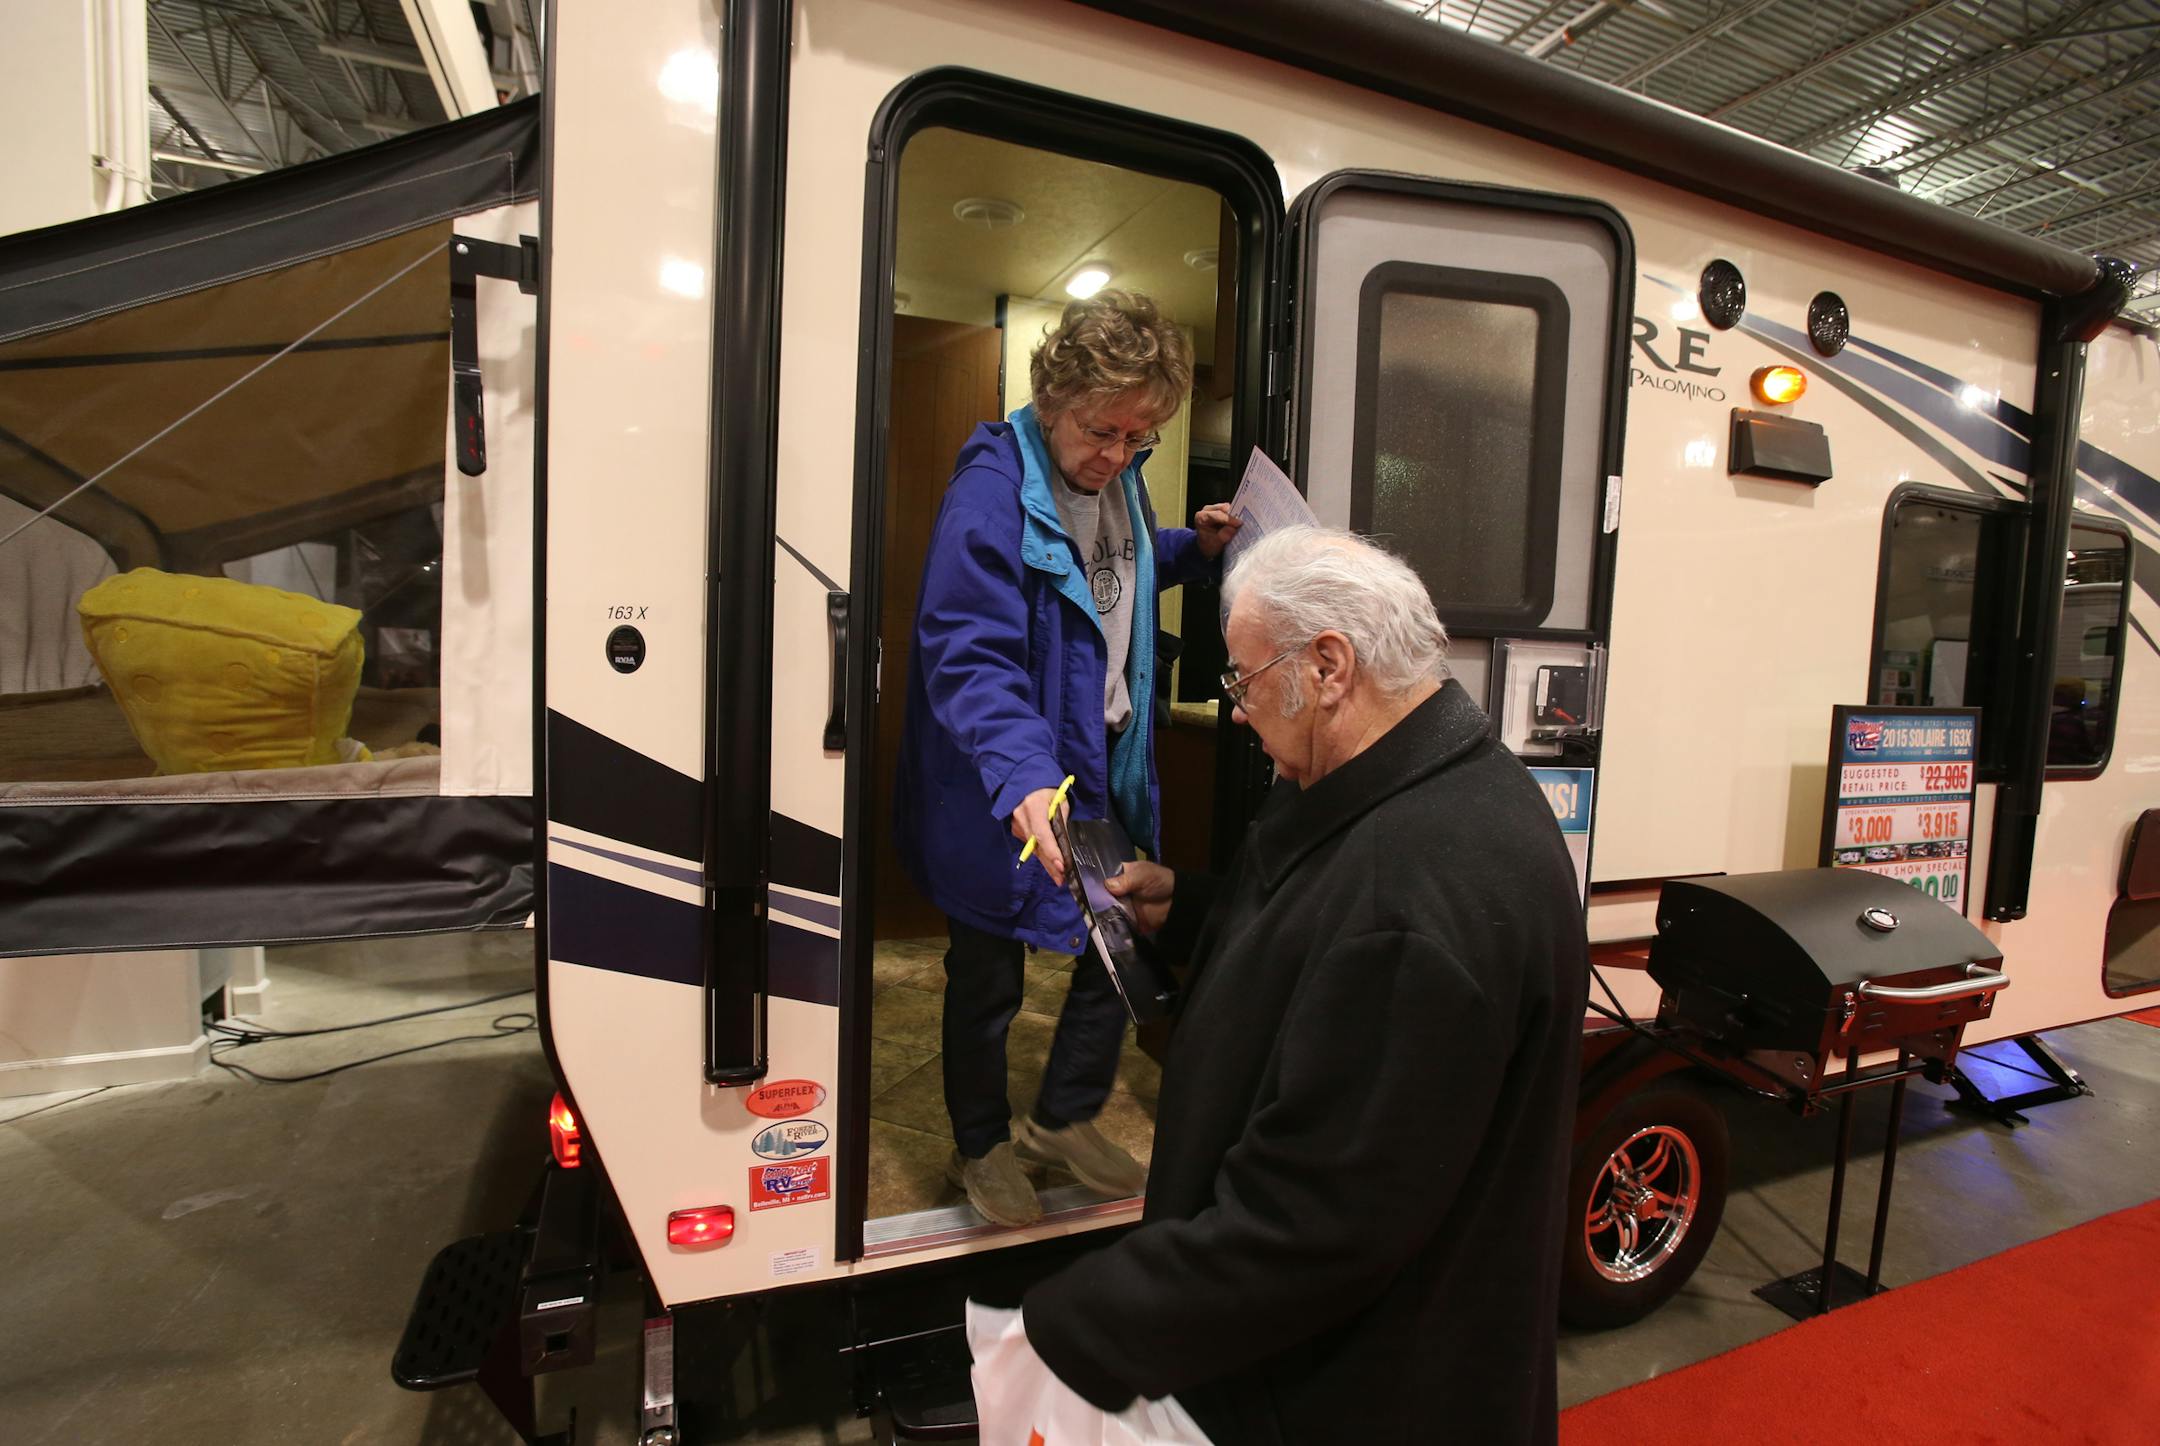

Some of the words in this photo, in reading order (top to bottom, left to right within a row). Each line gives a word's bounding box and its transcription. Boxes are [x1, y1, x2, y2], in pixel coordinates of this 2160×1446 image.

[1630, 368, 1726, 401] PALOMINO
[608, 606, 634, 619] 163
[636, 606, 649, 619] X
[1882, 728, 1908, 748] 2015
[1909, 728, 1947, 748] SOLAIRE
[1949, 728, 1972, 748] 163X
[1843, 768, 1900, 779] SUGGESTED
[1842, 782, 1874, 793] RETAIL
[1849, 815, 1893, 844] $3,000
[1918, 811, 1958, 839] $3,915
[1895, 865, 1922, 875] SHOW
[759, 1086, 814, 1100] SUPERFLEX
[794, 1130, 818, 1140] RIVER
[766, 1176, 792, 1192] RV
